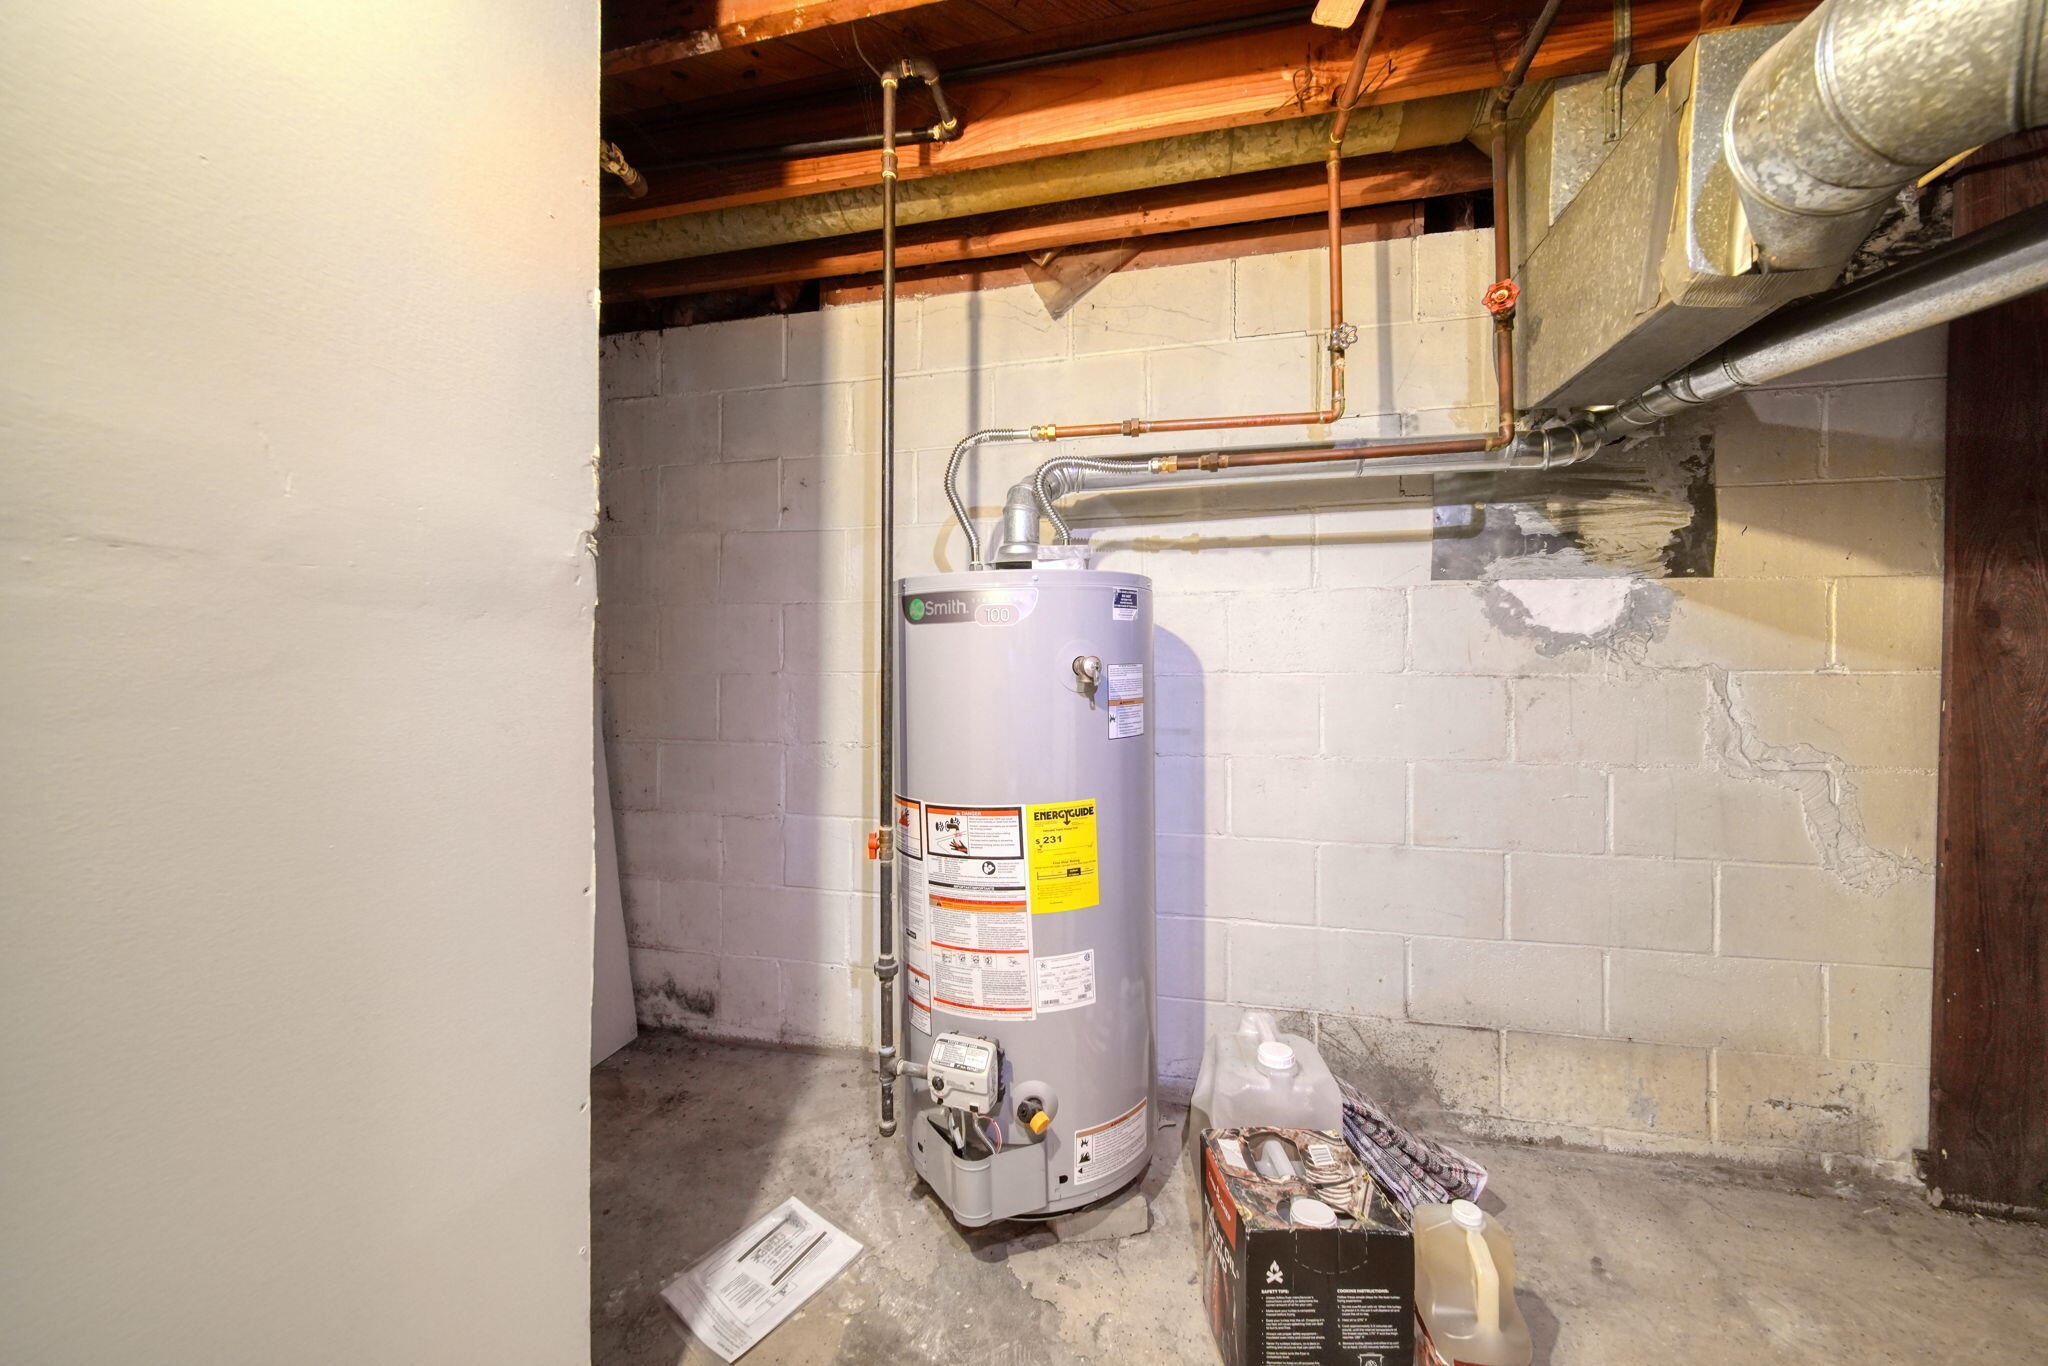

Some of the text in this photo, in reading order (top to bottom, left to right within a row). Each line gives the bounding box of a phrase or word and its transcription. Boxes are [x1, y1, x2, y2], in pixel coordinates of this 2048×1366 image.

[985, 608, 1010, 622] 100
[1034, 806, 1094, 821] ENERGYGUIDE
[1043, 835, 1062, 844] 231
